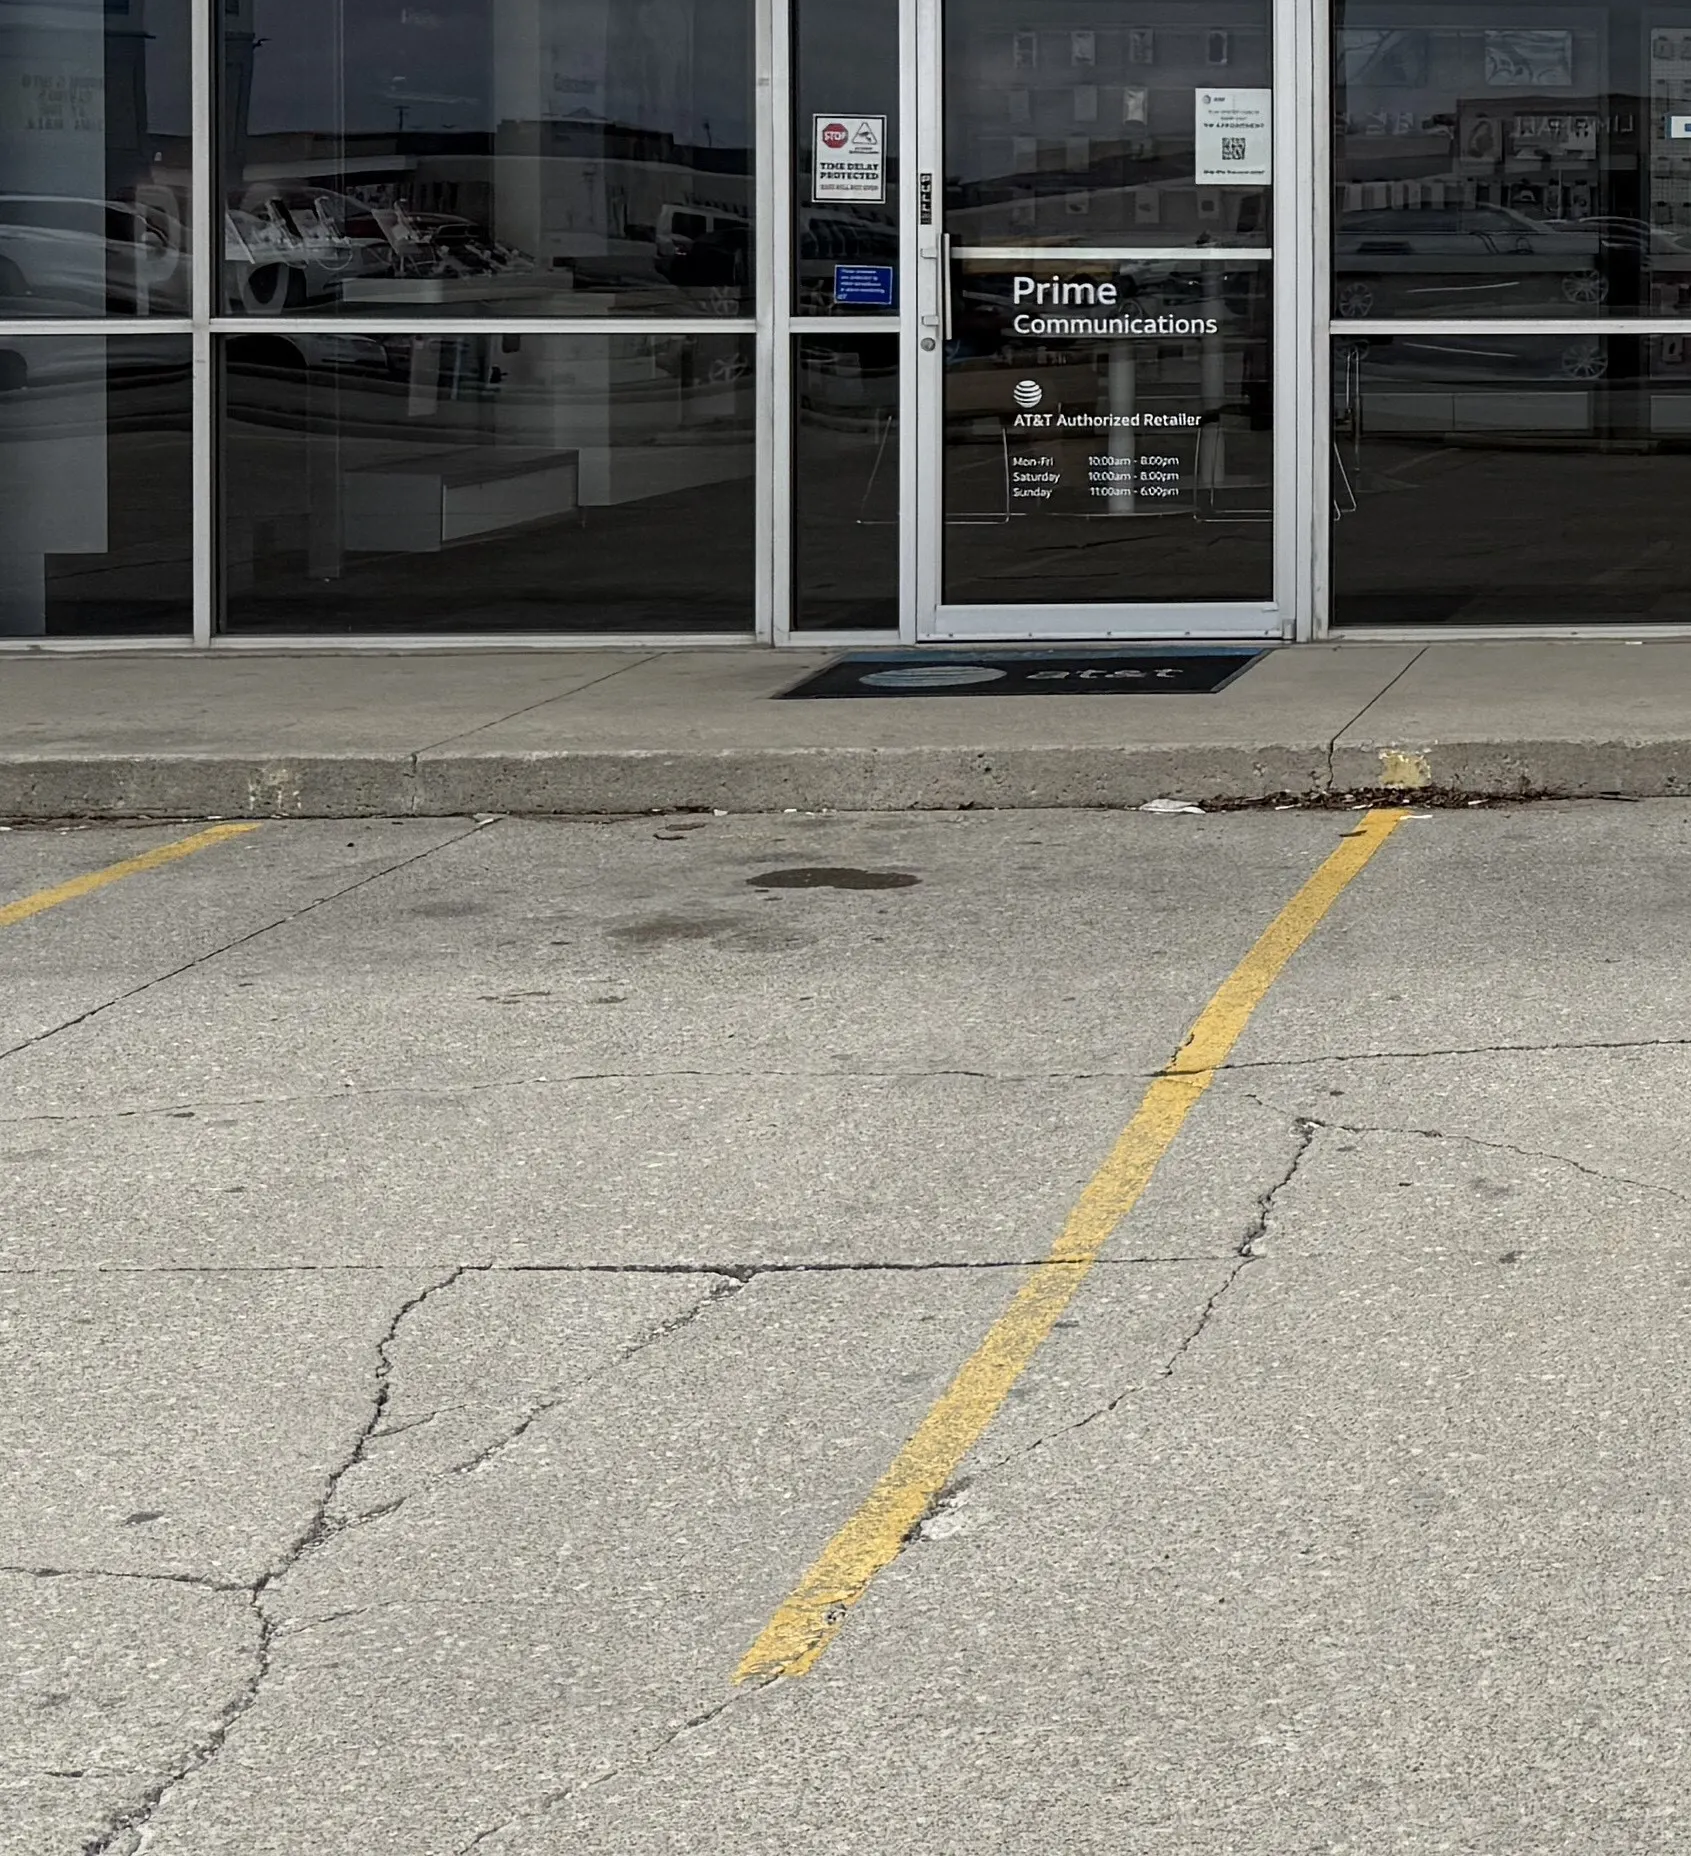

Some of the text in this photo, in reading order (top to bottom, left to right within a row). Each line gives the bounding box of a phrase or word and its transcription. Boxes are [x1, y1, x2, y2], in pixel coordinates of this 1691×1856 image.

[824, 131, 847, 141] STOP
[847, 162, 879, 171] DELAY
[820, 172, 879, 180] PROTECTED
[1013, 275, 1118, 305] Prime
[1013, 314, 1218, 334] Communications
[1013, 413, 1202, 427] AT&T Authorized Retailer
[1012, 456, 1053, 467] Mon-Fri
[1088, 456, 1131, 466] 10:00am
[1012, 471, 1060, 484] Saturday
[1088, 471, 1131, 481] 10:00am
[1012, 487, 1053, 499] Sunday
[1090, 487, 1131, 496] 11:00am
